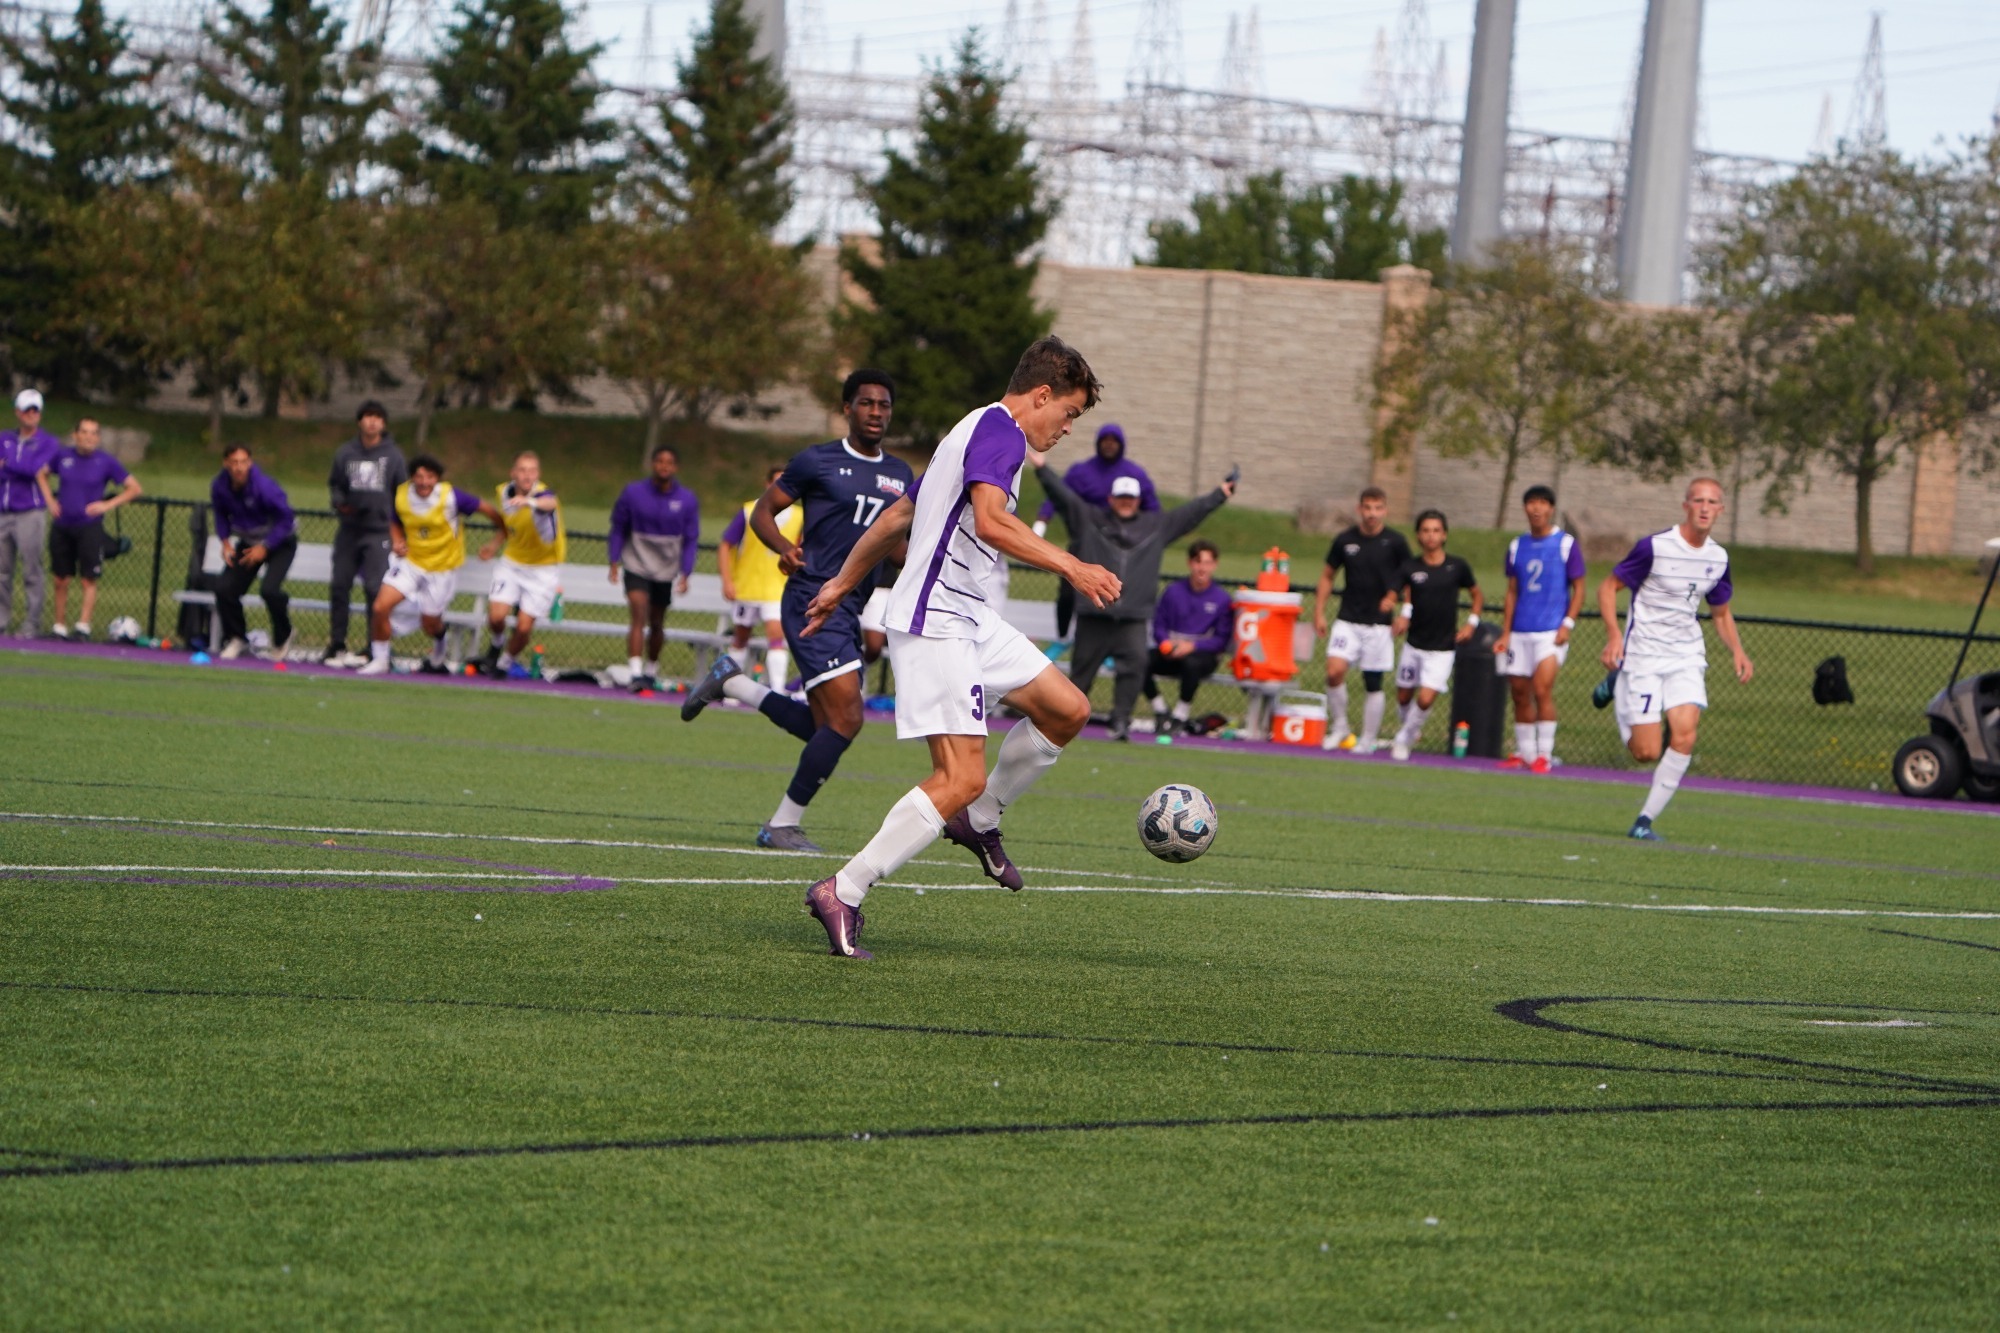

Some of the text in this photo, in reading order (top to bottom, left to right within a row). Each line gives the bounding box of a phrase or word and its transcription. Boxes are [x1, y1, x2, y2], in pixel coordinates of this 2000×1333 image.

[853, 494, 885, 527] 17
[1526, 559, 1543, 593] 2
[1687, 583, 1697, 601] 7
[1236, 611, 1259, 641] G
[970, 684, 984, 721] 3
[1640, 694, 1653, 714] 7
[1282, 716, 1305, 743] G
